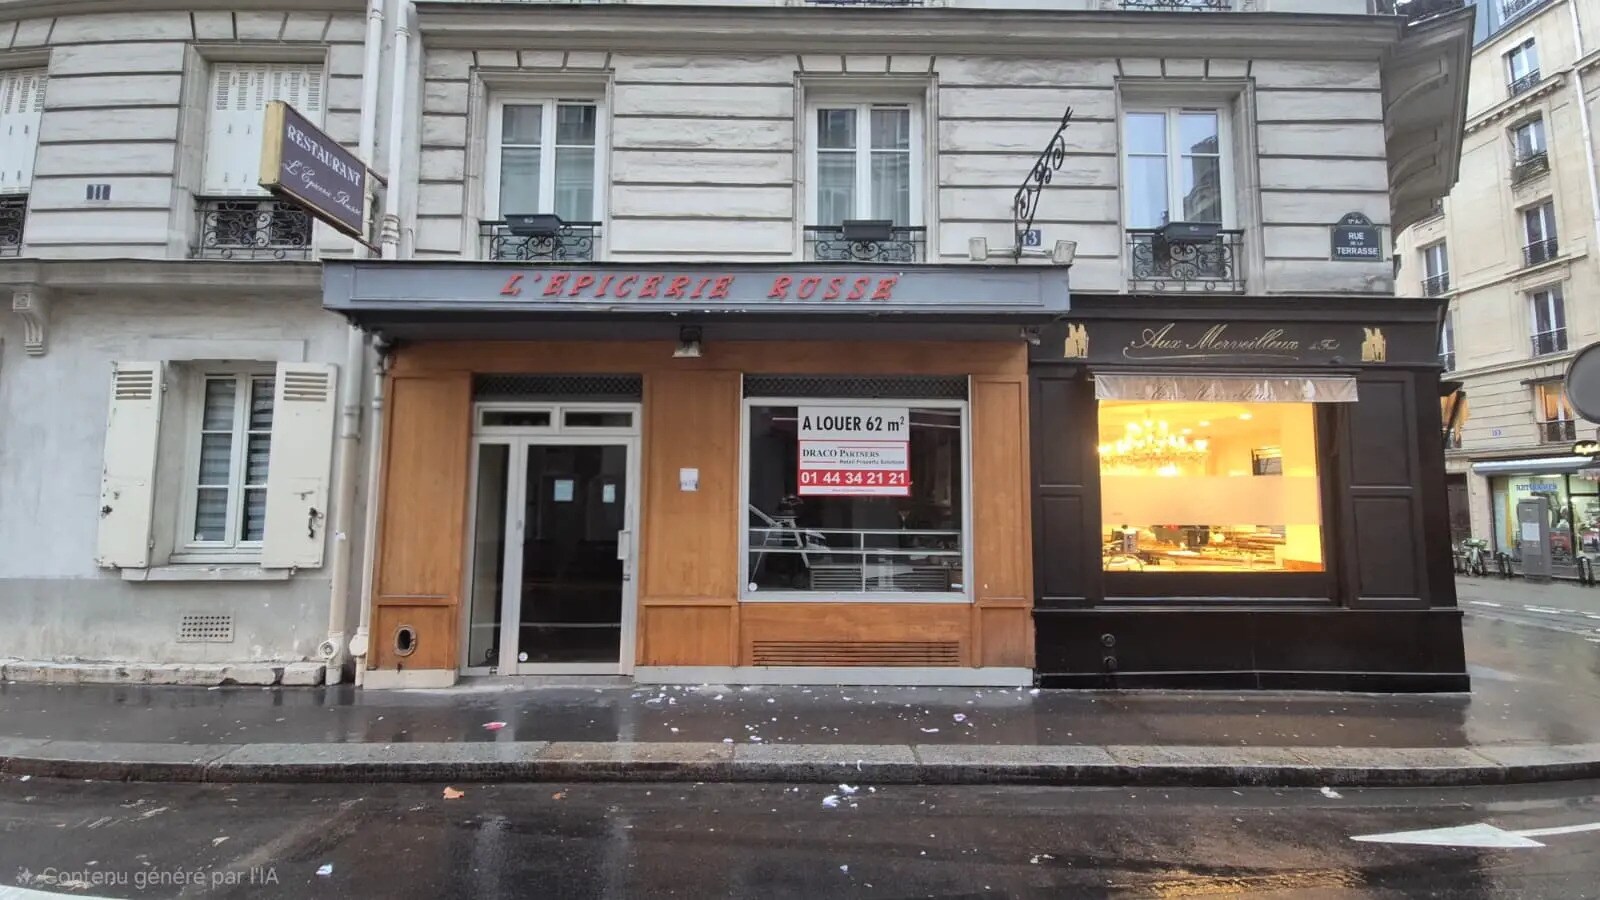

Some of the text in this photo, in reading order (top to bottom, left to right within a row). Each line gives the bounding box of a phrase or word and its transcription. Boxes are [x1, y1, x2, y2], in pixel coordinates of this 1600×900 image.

[288, 125, 361, 187] RESTAURANT
[1348, 231, 1364, 240] RUE
[1336, 247, 1378, 255] TERRASSE
[500, 272, 899, 300] L'EPICERIE RUSSE
[1130, 322, 1182, 349] Aux
[1186, 323, 1299, 350] Merveilleux
[803, 416, 811, 431] A
[817, 416, 861, 431] LOUER
[866, 416, 882, 431] 62
[803, 449, 837, 457] DRACO
[801, 471, 905, 484] 01 44 34 21 21
